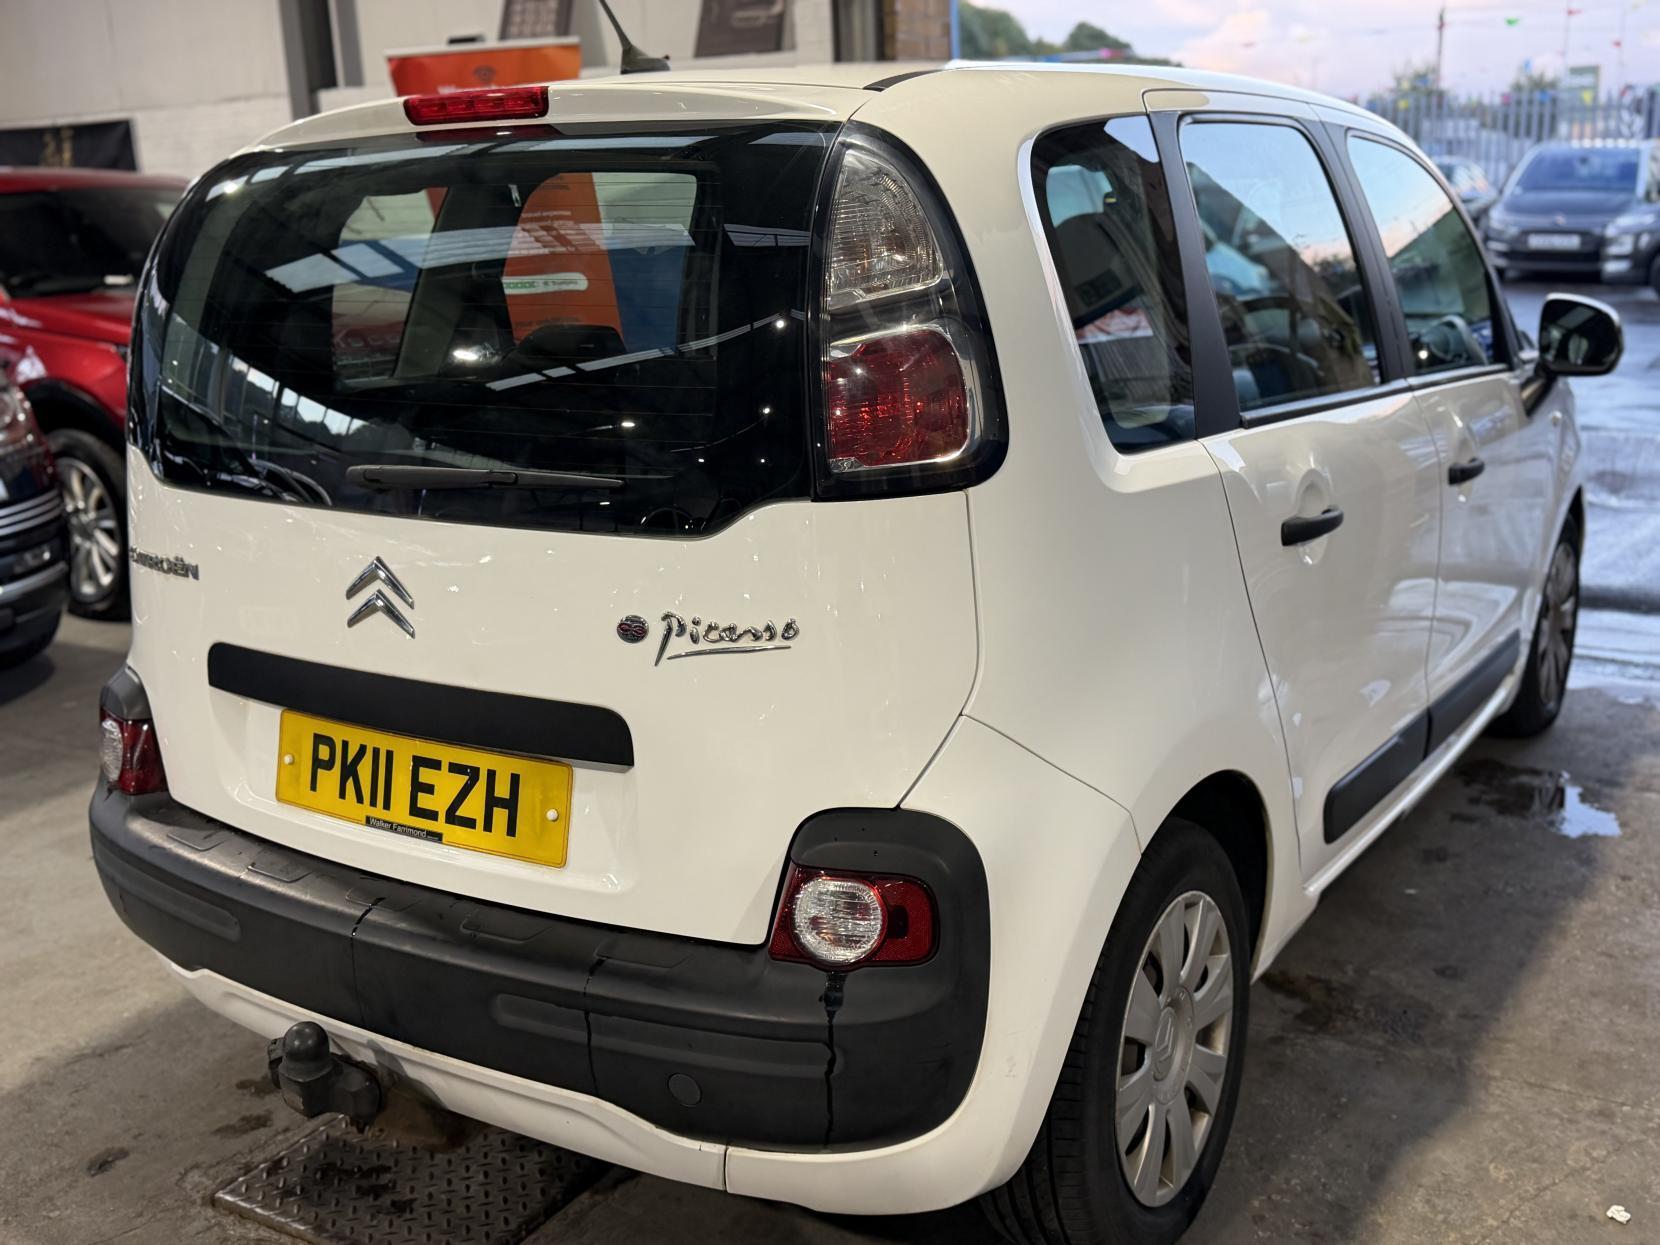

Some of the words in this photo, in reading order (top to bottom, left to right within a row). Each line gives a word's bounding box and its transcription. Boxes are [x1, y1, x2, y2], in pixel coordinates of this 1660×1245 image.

[654, 611, 800, 667] Picasso
[310, 732, 394, 811] PK11
[409, 755, 520, 837] EZH
[369, 818, 392, 830] Walker
